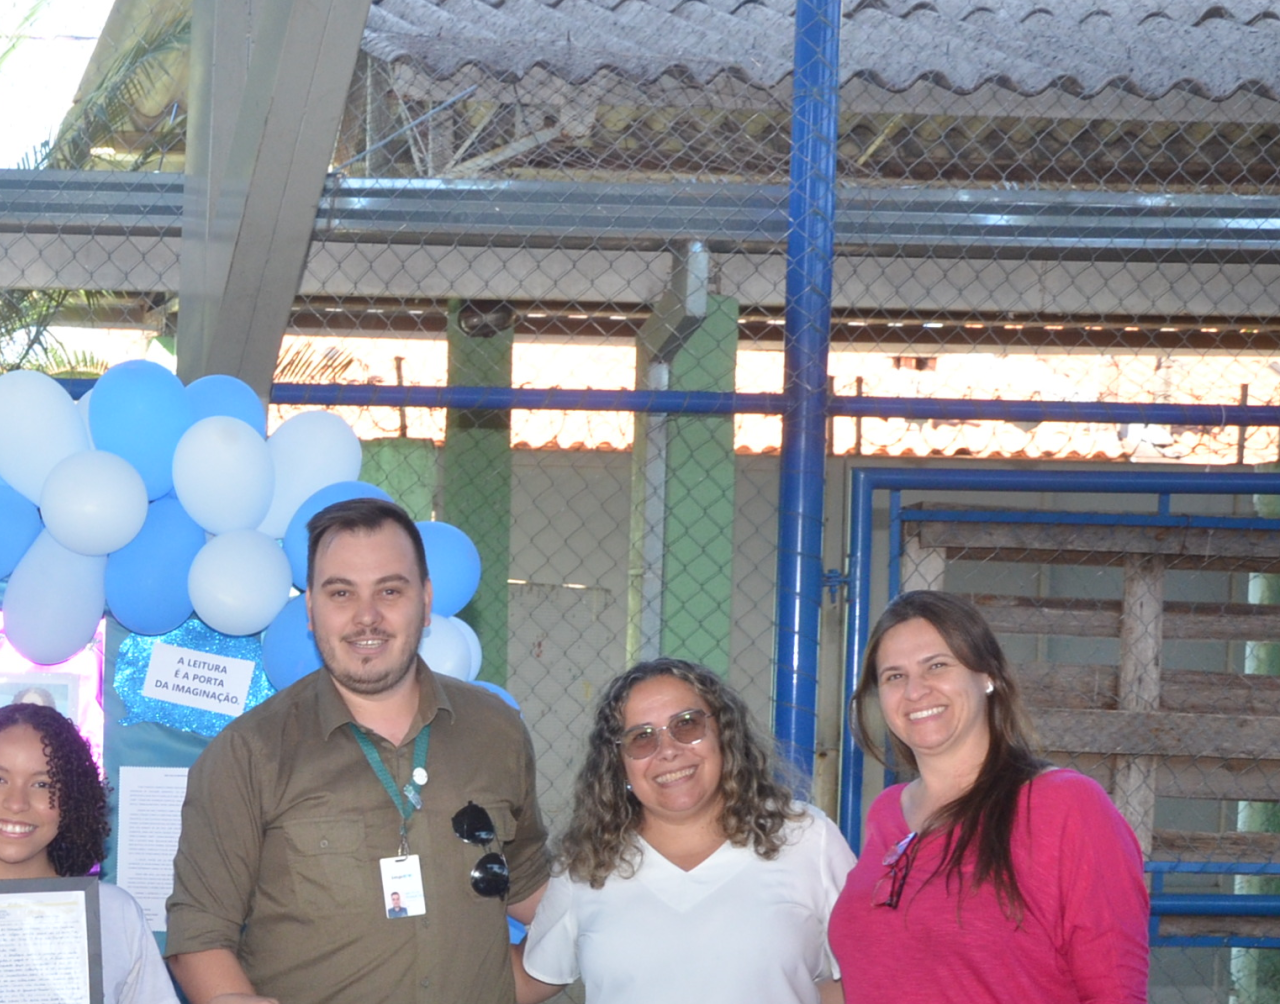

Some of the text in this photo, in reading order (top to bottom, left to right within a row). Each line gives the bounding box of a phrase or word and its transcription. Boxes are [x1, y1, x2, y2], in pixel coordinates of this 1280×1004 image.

[177, 656, 228, 675] A LEITURA
[173, 668, 225, 688] É A PORTA
[154, 679, 240, 706] DA IMAGINAÇÃO.
